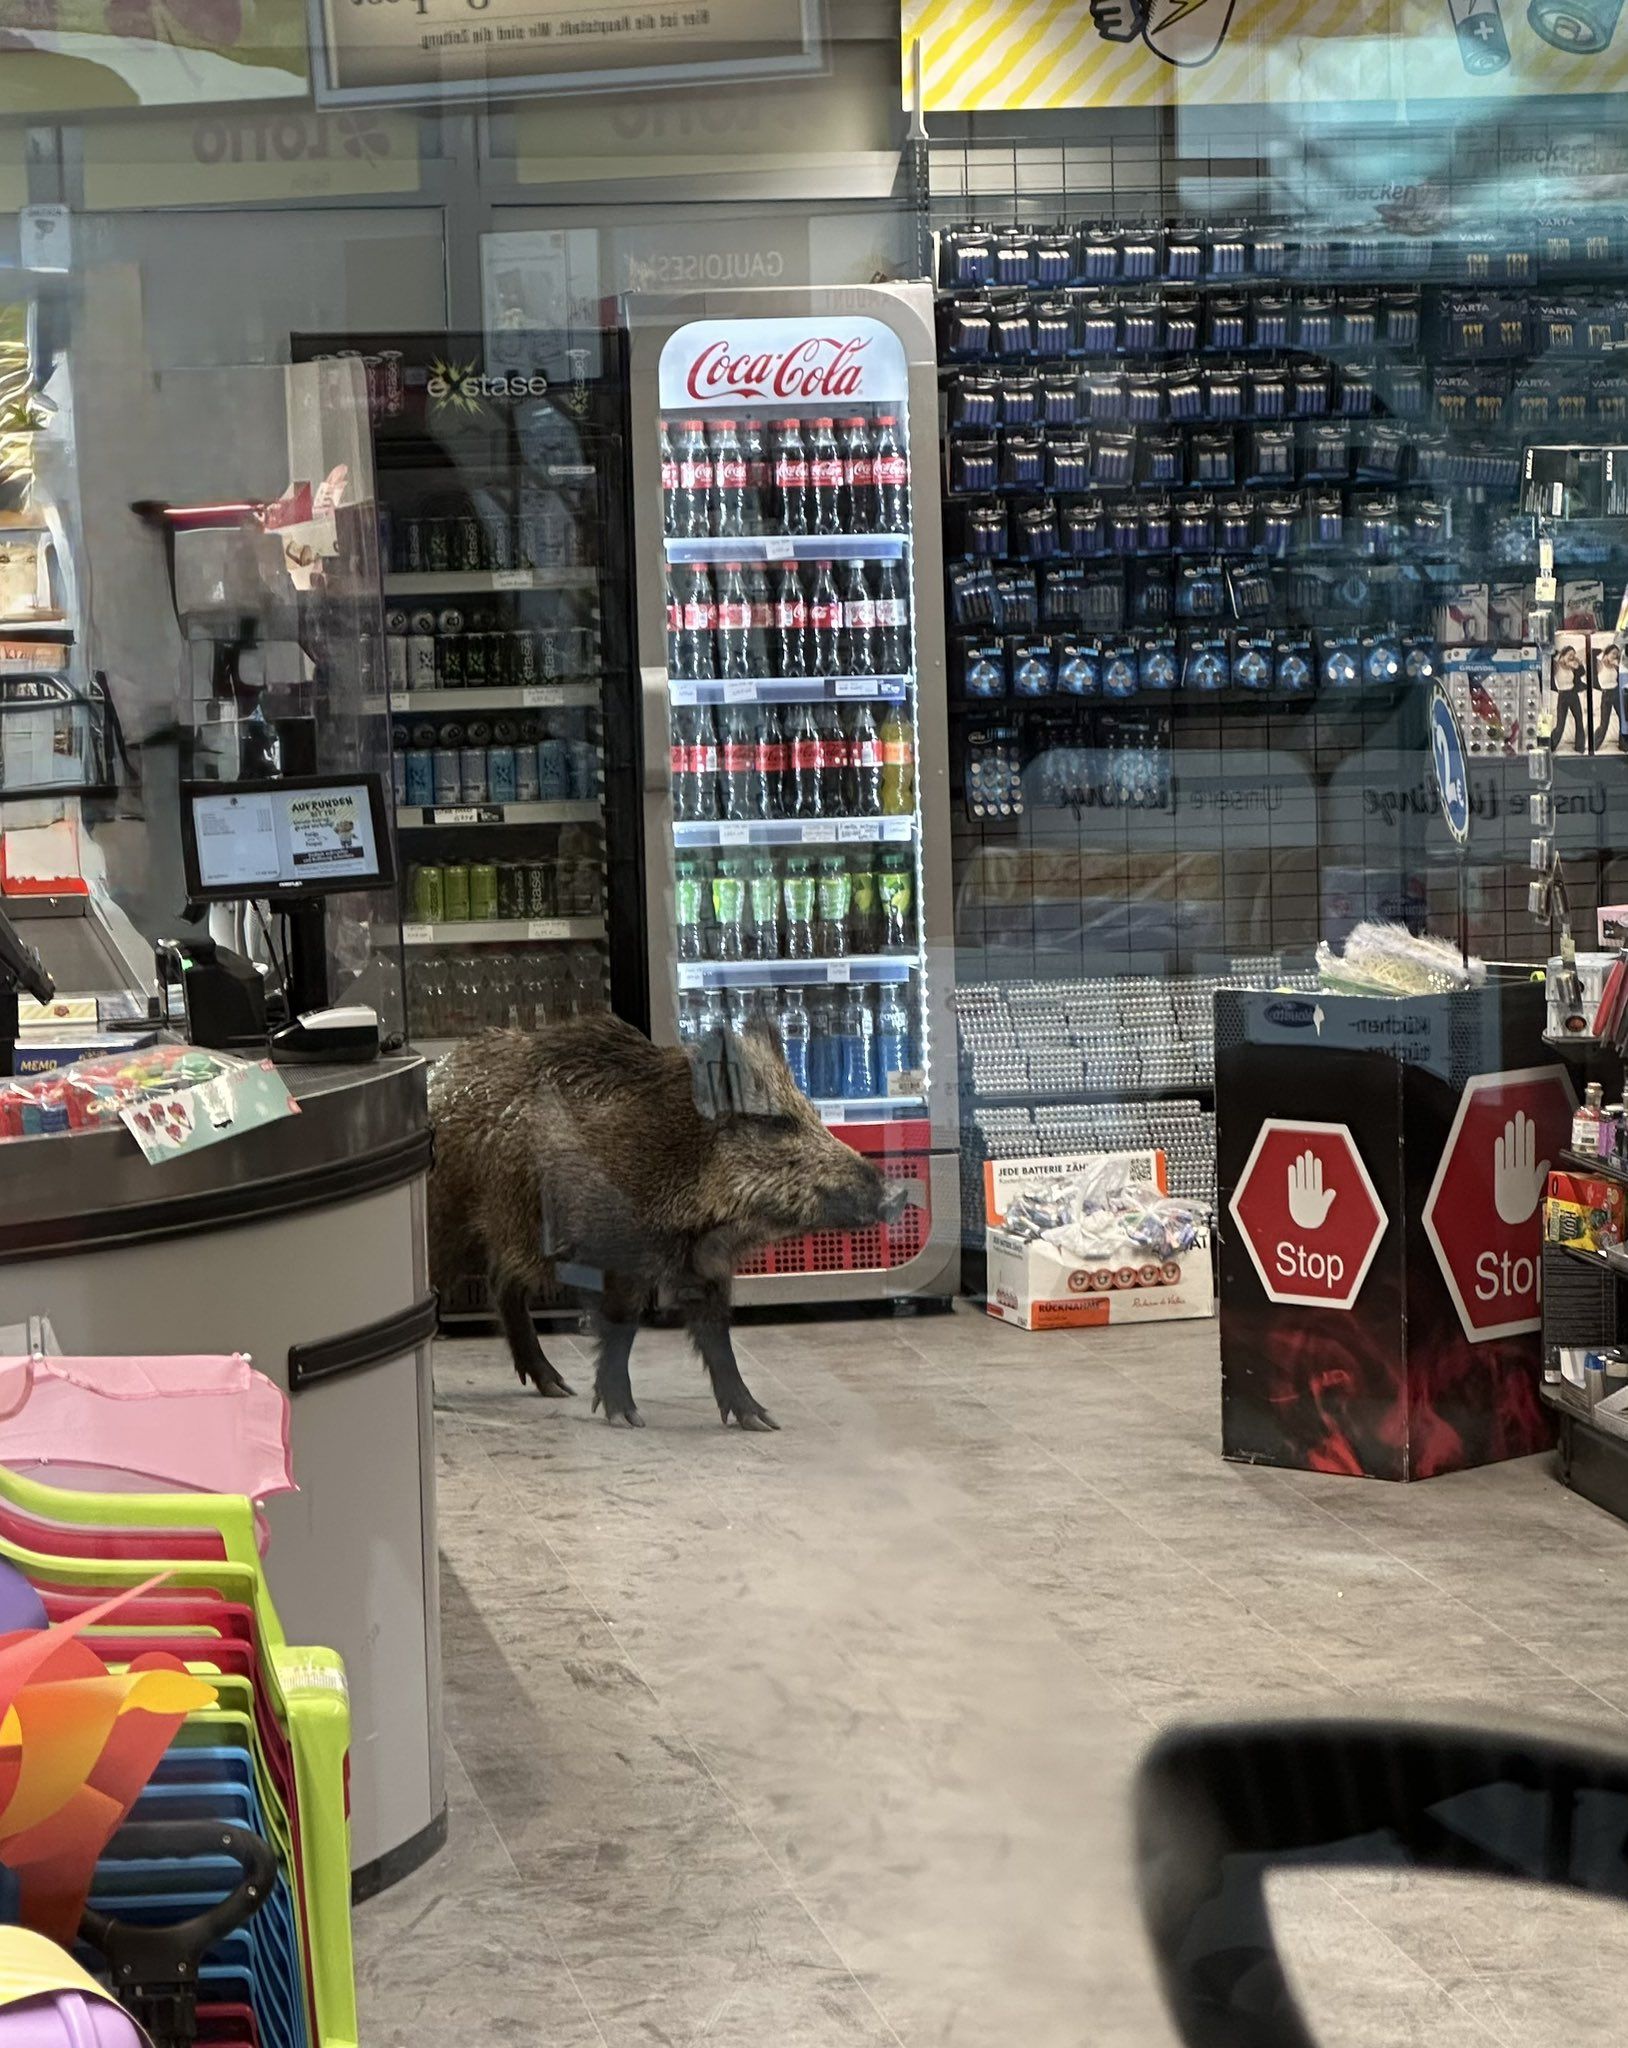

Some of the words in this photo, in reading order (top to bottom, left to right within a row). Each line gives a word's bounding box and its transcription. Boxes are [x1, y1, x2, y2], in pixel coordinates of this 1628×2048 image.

[1453, 303, 1490, 313] VARTA
[1540, 306, 1577, 317] VARTA
[291, 796, 354, 813] AUFRUNDEN
[998, 1167, 1019, 1177] JEDE
[1022, 1165, 1063, 1175] BATTERIE
[1066, 1162, 1089, 1173] ZÄH
[1276, 1241, 1344, 1289] Stop
